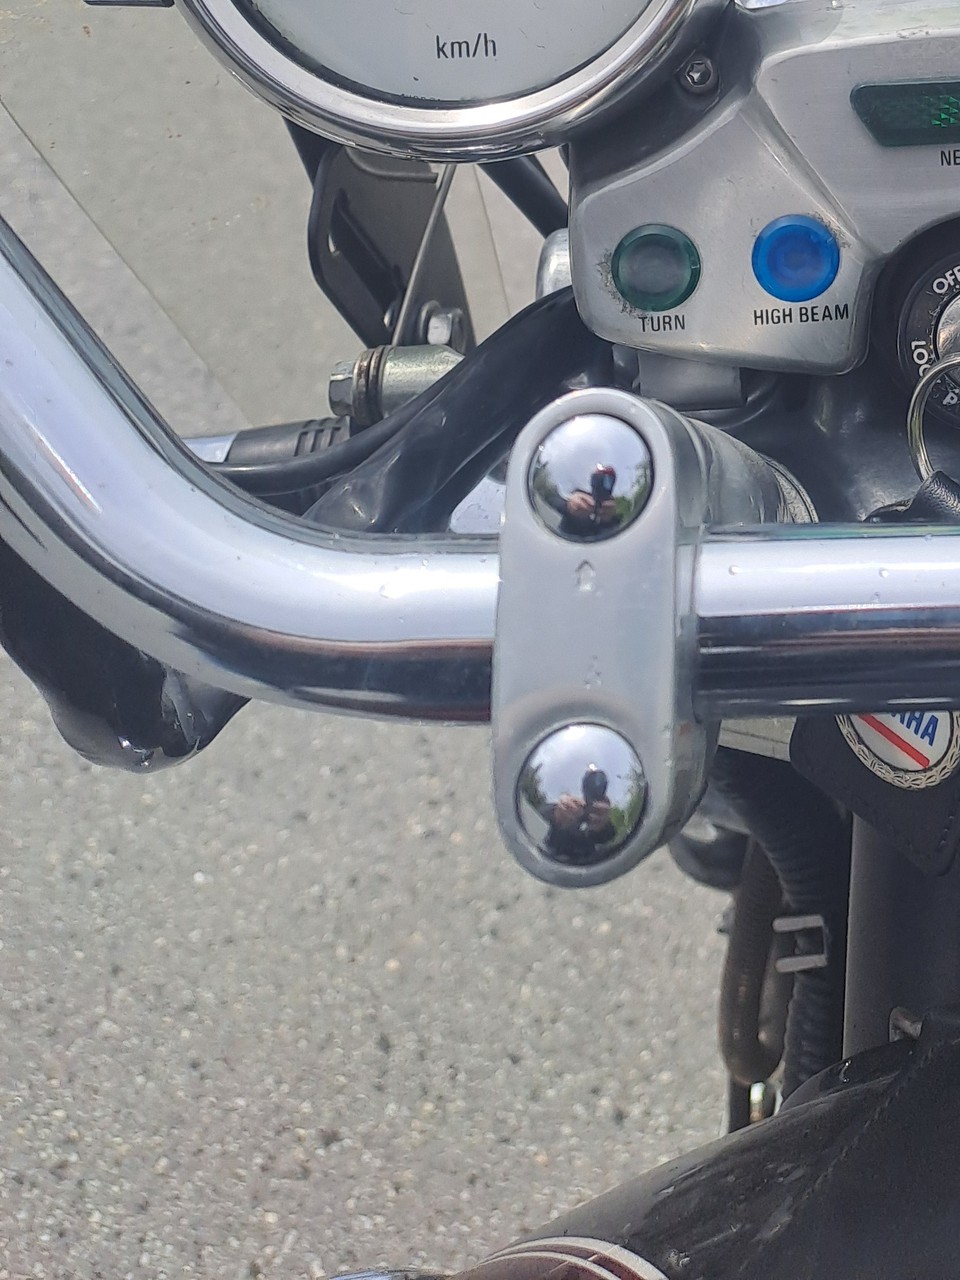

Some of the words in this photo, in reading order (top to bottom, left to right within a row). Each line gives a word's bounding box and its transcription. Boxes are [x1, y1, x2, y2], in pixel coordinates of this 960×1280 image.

[435, 32, 498, 60] km/h
[637, 314, 686, 333] TURN
[753, 307, 794, 326] HIGH
[799, 303, 850, 323] BEAM
[911, 340, 932, 378] LOC
